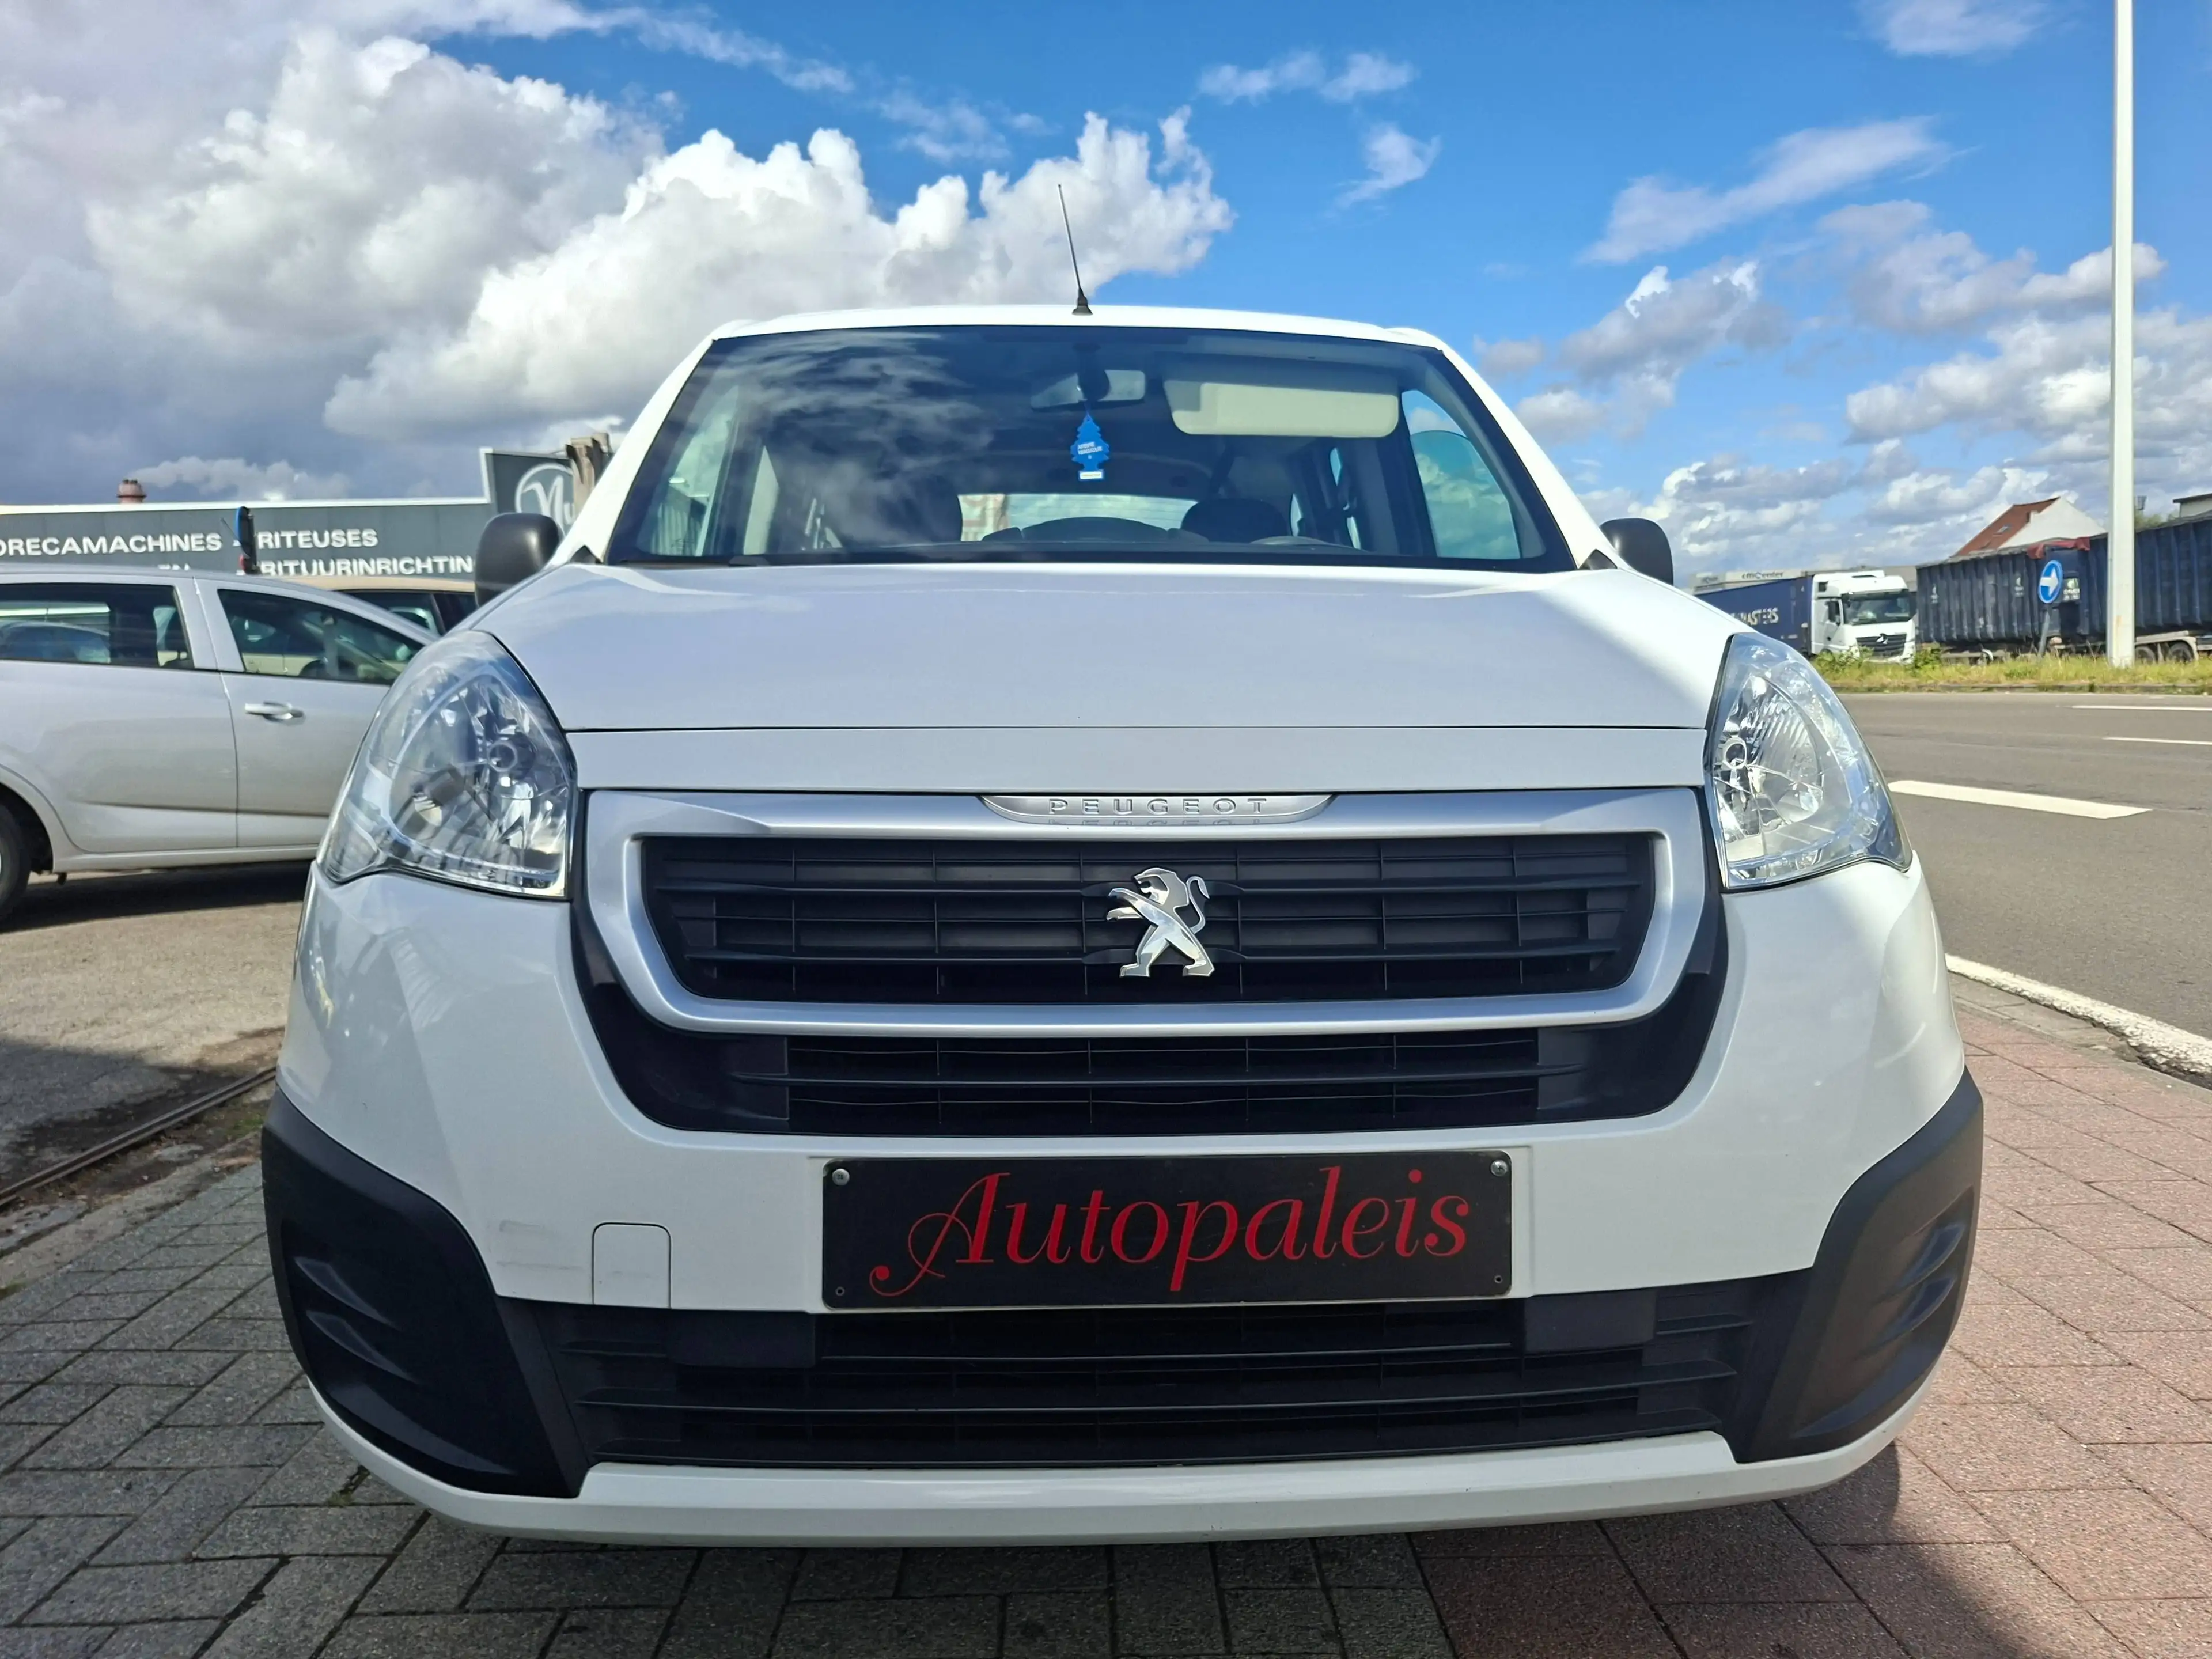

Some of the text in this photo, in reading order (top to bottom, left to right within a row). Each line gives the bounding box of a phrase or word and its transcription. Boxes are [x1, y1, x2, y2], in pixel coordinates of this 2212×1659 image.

[254, 528, 378, 549] RITEUSES
[257, 555, 475, 576] RITUURINRICHTIN
[1048, 798, 1267, 814] PEUGEOT
[869, 1166, 1469, 1296] Autopaleis
